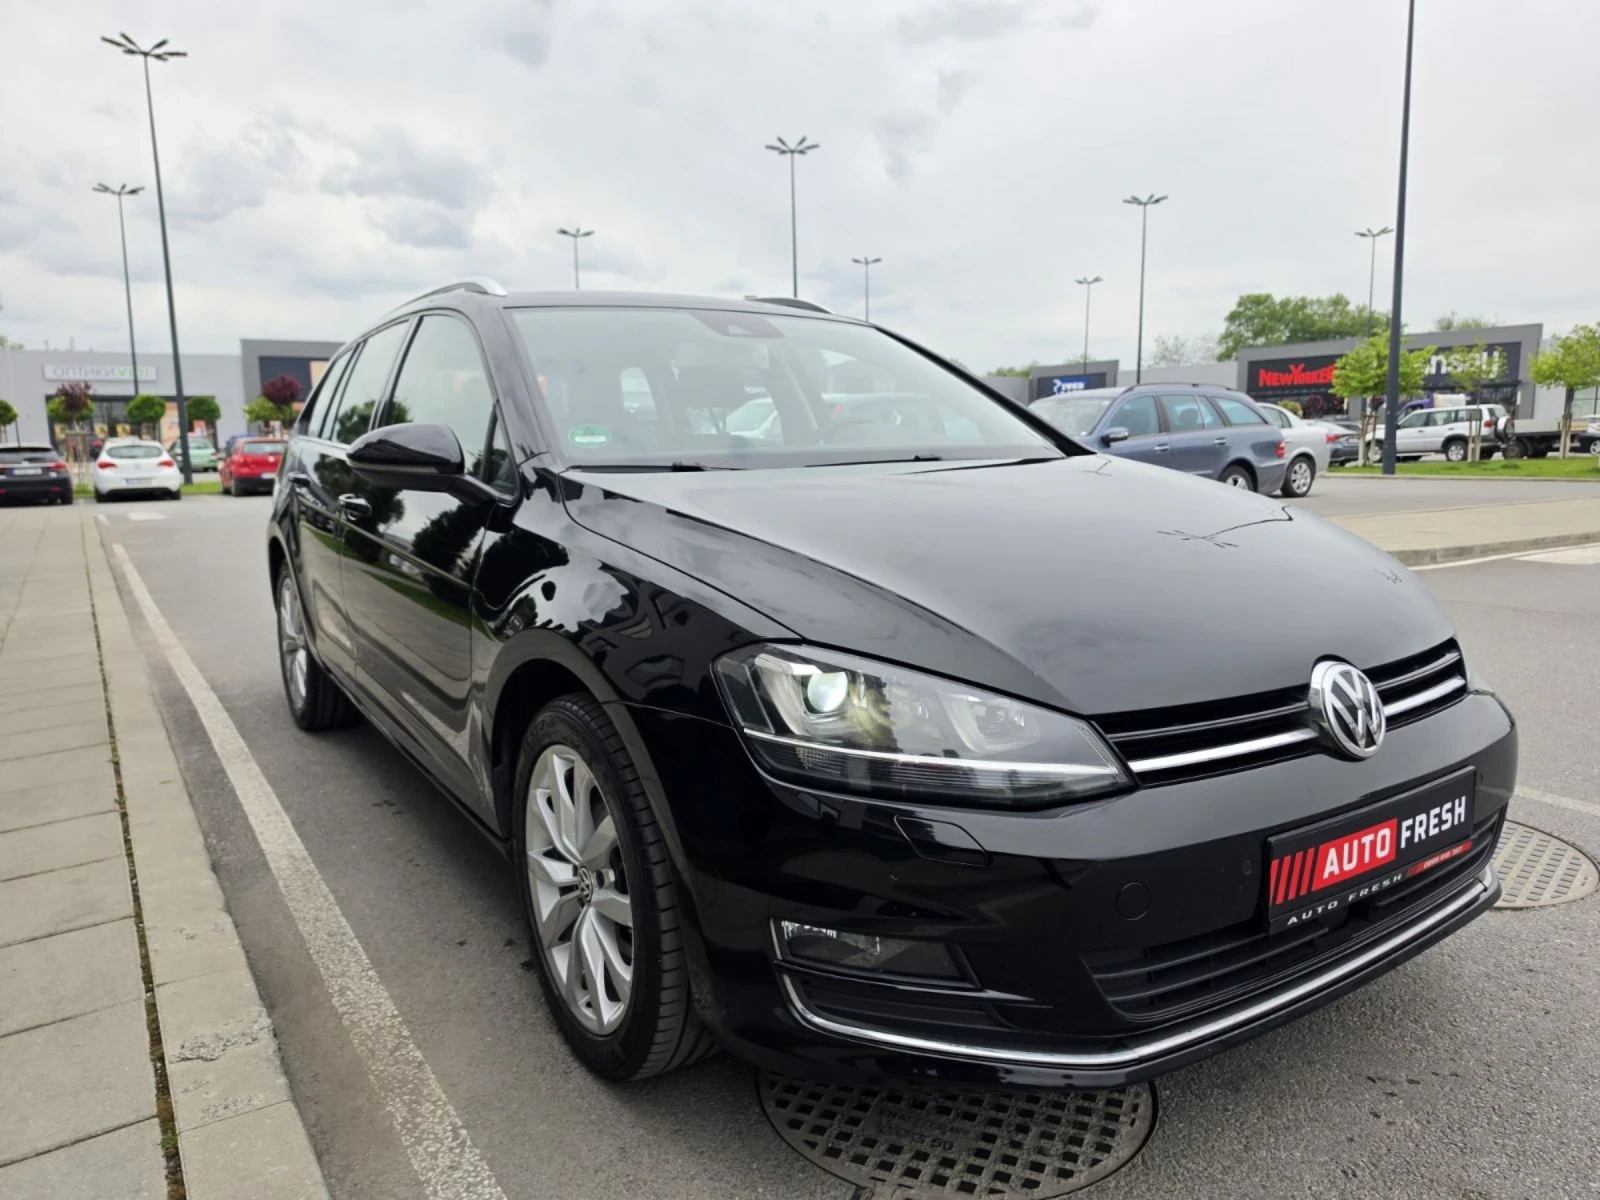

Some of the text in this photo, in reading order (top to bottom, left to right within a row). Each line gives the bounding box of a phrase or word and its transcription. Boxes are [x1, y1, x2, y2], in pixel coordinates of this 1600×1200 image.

[1323, 827, 1391, 879] AUTO
[1401, 796, 1466, 849] FRESH
[1287, 874, 1402, 926] AUTO FRESH
